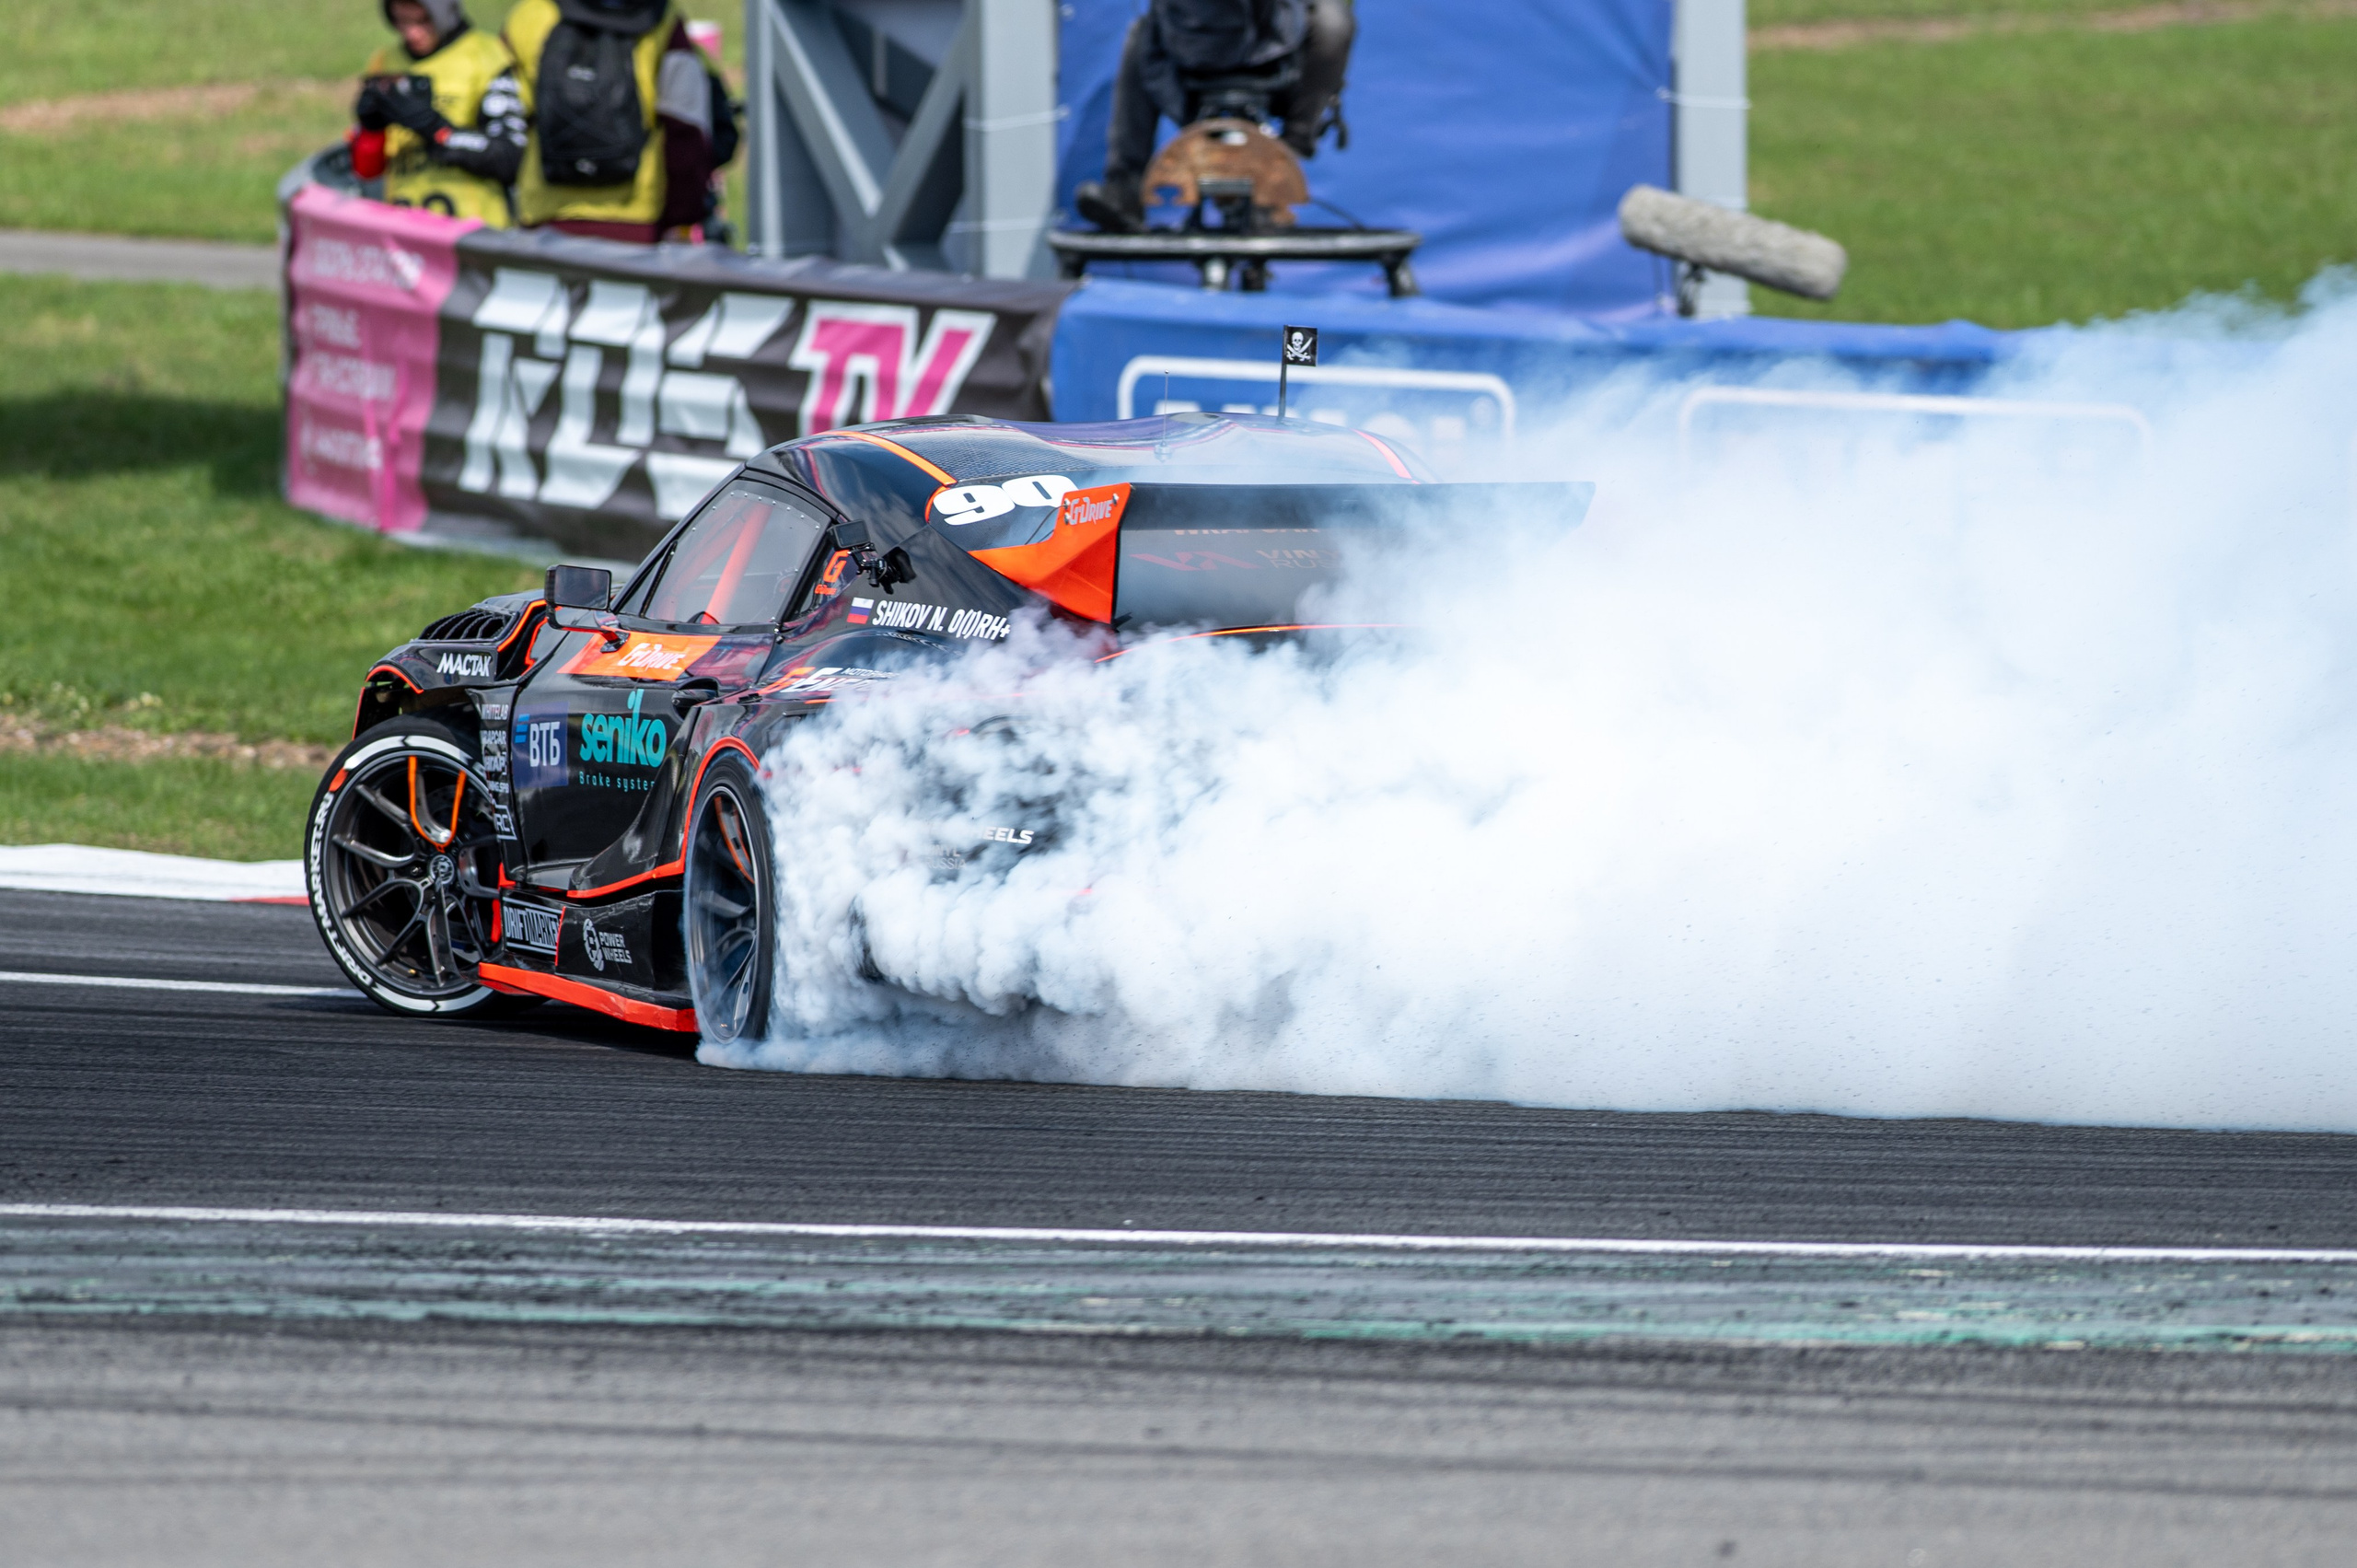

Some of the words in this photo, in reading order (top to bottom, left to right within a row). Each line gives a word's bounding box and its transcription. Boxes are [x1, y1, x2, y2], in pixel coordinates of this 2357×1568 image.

[788, 299, 998, 436] TV
[933, 474, 1080, 526] 90
[872, 600, 933, 629] SHIKOV
[926, 606, 948, 632] N.
[529, 721, 561, 767] ВТБ
[579, 689, 667, 768] seniko
[578, 771, 610, 787] Brake
[599, 931, 626, 948] POWER
[601, 947, 633, 964] WHEELS
